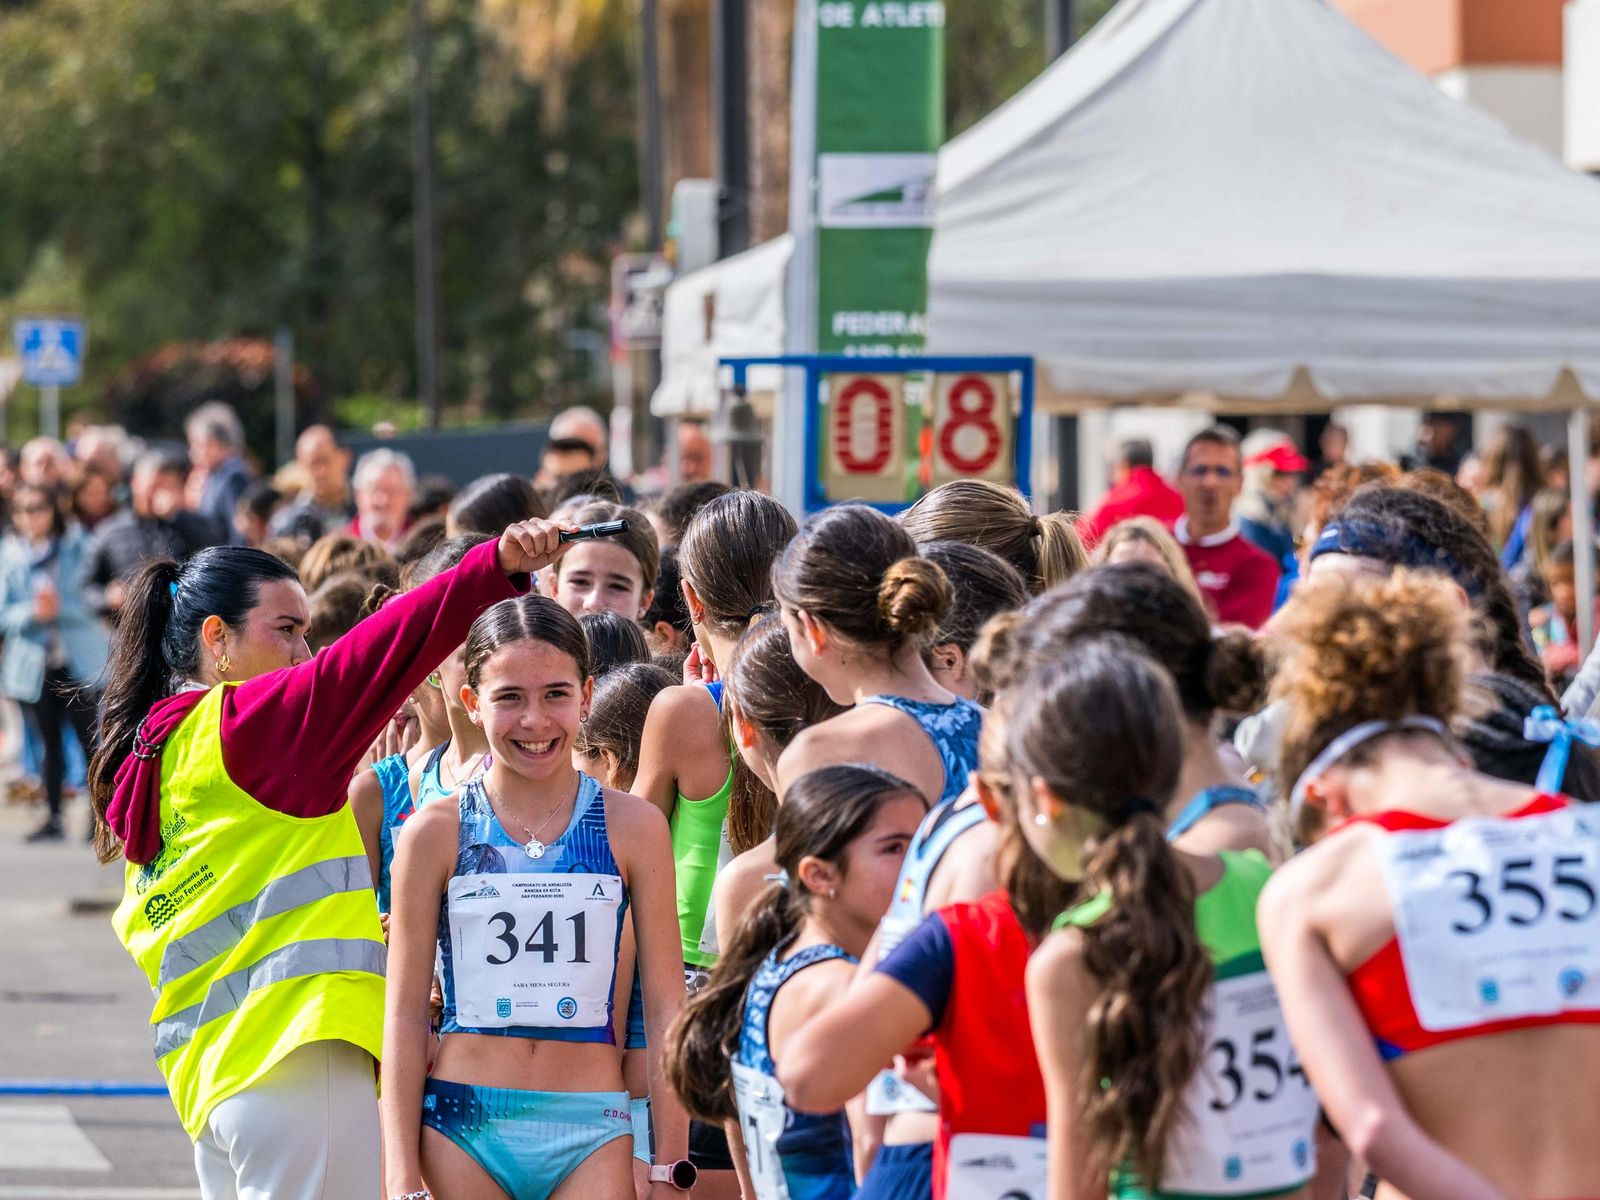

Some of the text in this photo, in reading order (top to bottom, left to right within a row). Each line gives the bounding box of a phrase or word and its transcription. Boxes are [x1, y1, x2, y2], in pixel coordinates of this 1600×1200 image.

[818, 2, 854, 28] DE
[168, 864, 209, 898] Ayuntamiento de
[183, 872, 214, 897] Fernando
[1445, 856, 1597, 934] 355
[486, 910, 591, 965] 341
